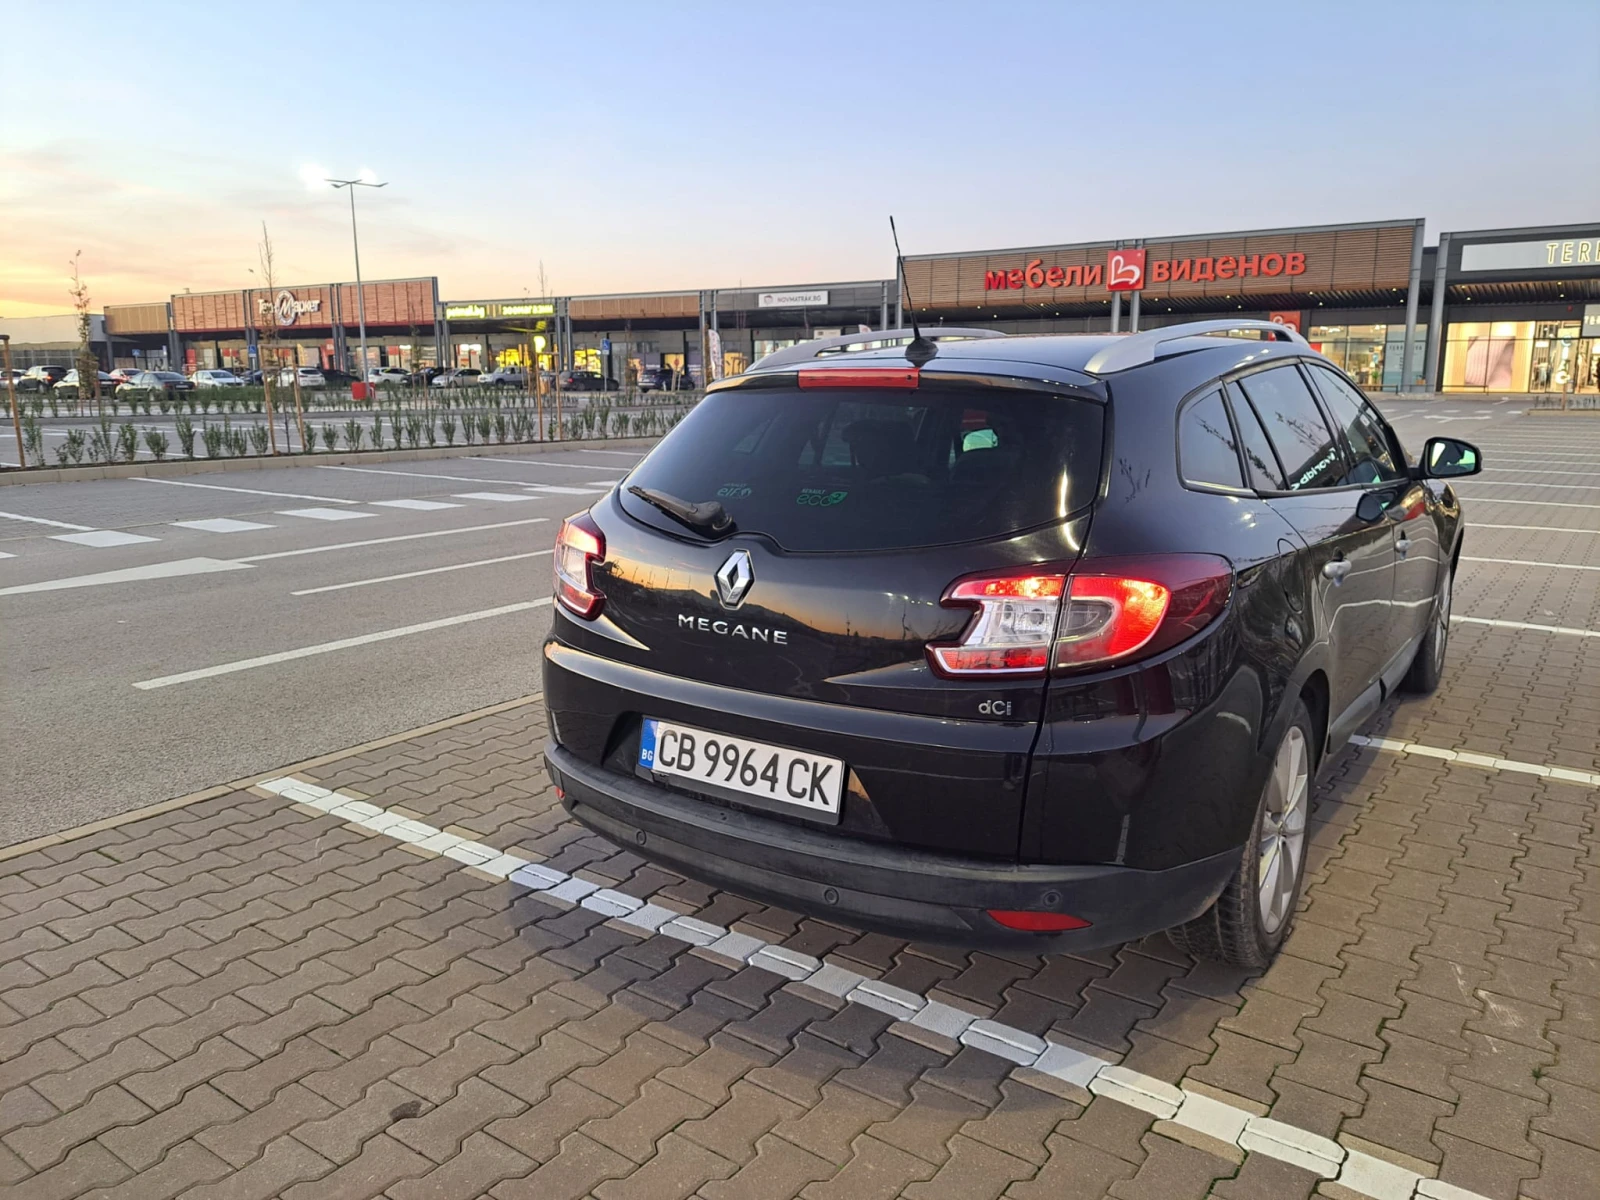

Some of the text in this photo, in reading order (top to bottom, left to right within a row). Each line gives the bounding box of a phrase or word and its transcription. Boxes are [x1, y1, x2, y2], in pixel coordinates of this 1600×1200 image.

[985, 252, 1306, 291] мебели виденов
[678, 614, 788, 645] MEGANE
[978, 699, 1011, 716] dCi
[641, 748, 653, 761] BG
[658, 729, 833, 806] CB 9964 CK
